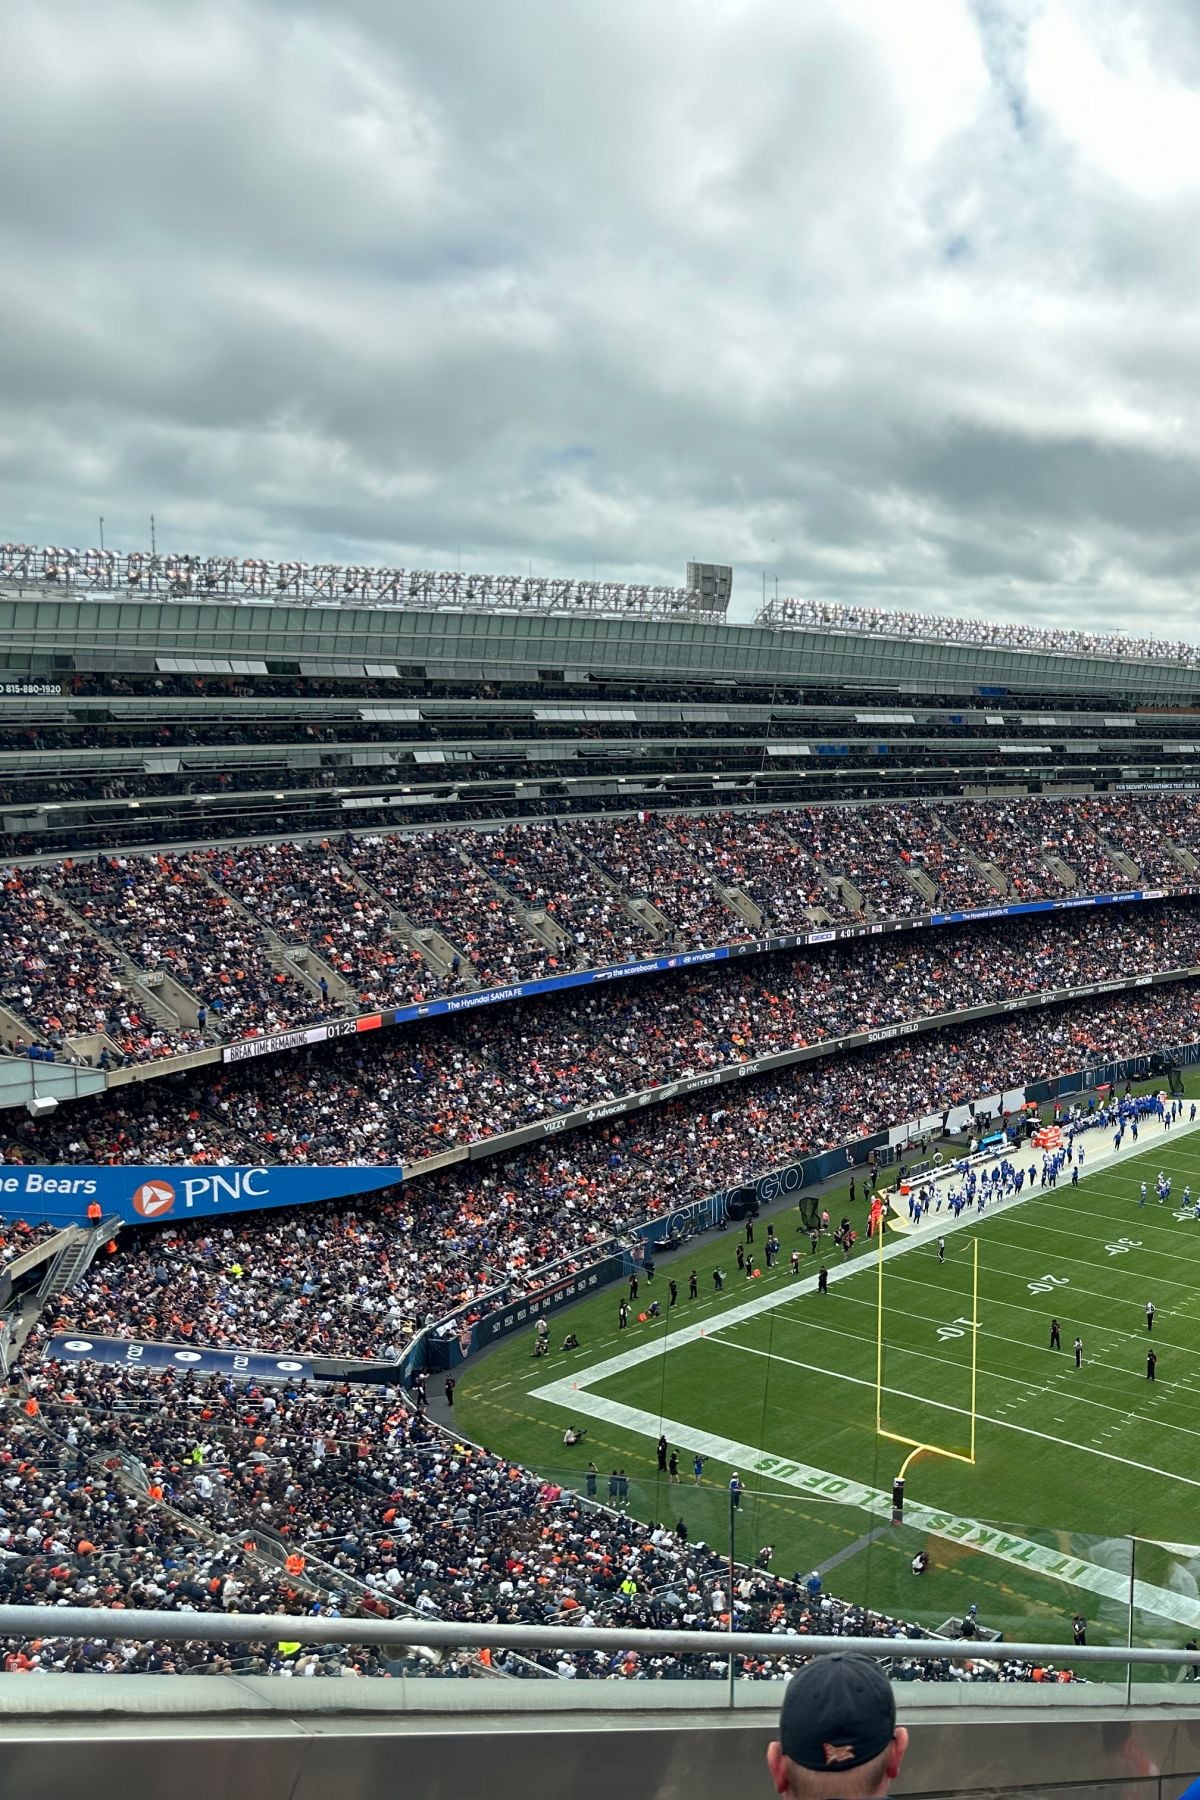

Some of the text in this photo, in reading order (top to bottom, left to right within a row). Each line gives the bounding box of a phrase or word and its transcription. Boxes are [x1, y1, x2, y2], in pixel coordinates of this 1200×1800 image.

[6, 684, 61, 693] 815-880-1920
[811, 933, 832, 942] GEICO
[840, 929, 855, 938] 4:01
[756, 944, 761, 952] 3
[613, 962, 659, 977] the scoreboard.
[447, 987, 523, 1010] The Hyundai SANTA FE
[327, 1021, 358, 1038] 01:25
[868, 1023, 919, 1042] SOLDIER FIELD
[230, 1031, 308, 1061] BREAK TIME REMAINING
[746, 1063, 760, 1073] PNC
[687, 1077, 713, 1089] UNITED
[595, 1103, 627, 1118] Advocate
[543, 1119, 567, 1132] VIZZY
[26, 1174, 97, 1194] Bears
[180, 1168, 270, 1208] PNC
[666, 1163, 804, 1238] CHICGO
[1108, 1237, 1143, 1254] 30
[1029, 1274, 1070, 1293] 20
[936, 1317, 983, 1338] 10
[753, 1457, 800, 1479] US
[803, 1475, 849, 1494] OF
[926, 1514, 1042, 1562] TAKES
[1046, 1559, 1089, 1580] IT
